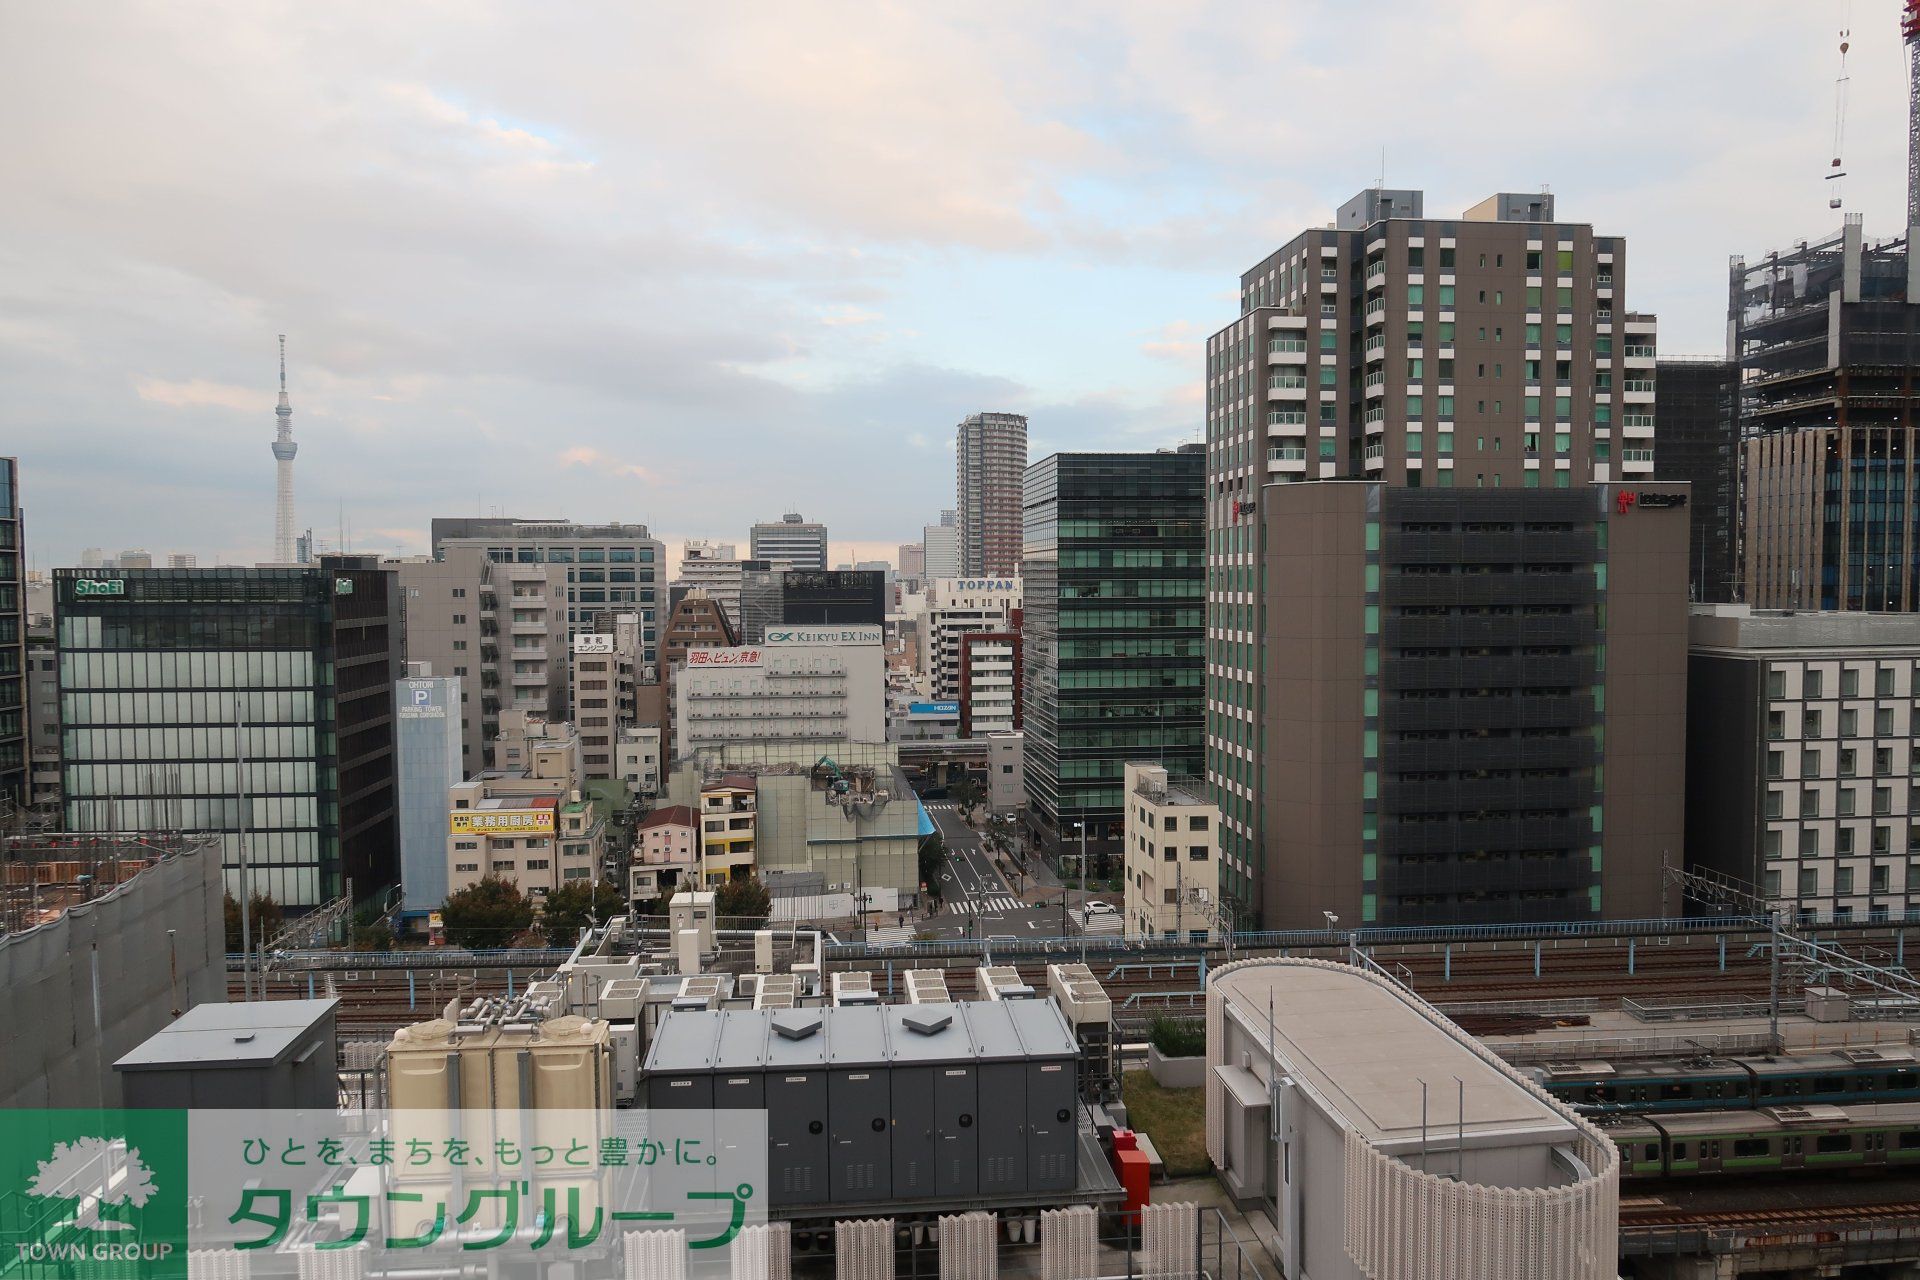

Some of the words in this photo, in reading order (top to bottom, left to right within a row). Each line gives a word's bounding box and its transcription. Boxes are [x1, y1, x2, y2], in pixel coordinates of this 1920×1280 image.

[76, 580, 123, 594] ShoEi
[957, 580, 1013, 590] TOPPAN
[797, 632, 838, 641] KEIKYU
[841, 632, 858, 641] EX
[859, 632, 880, 641] INN
[408, 681, 434, 689] OHTORI
[415, 690, 428, 705] P
[471, 815, 534, 827] 業務用厨房
